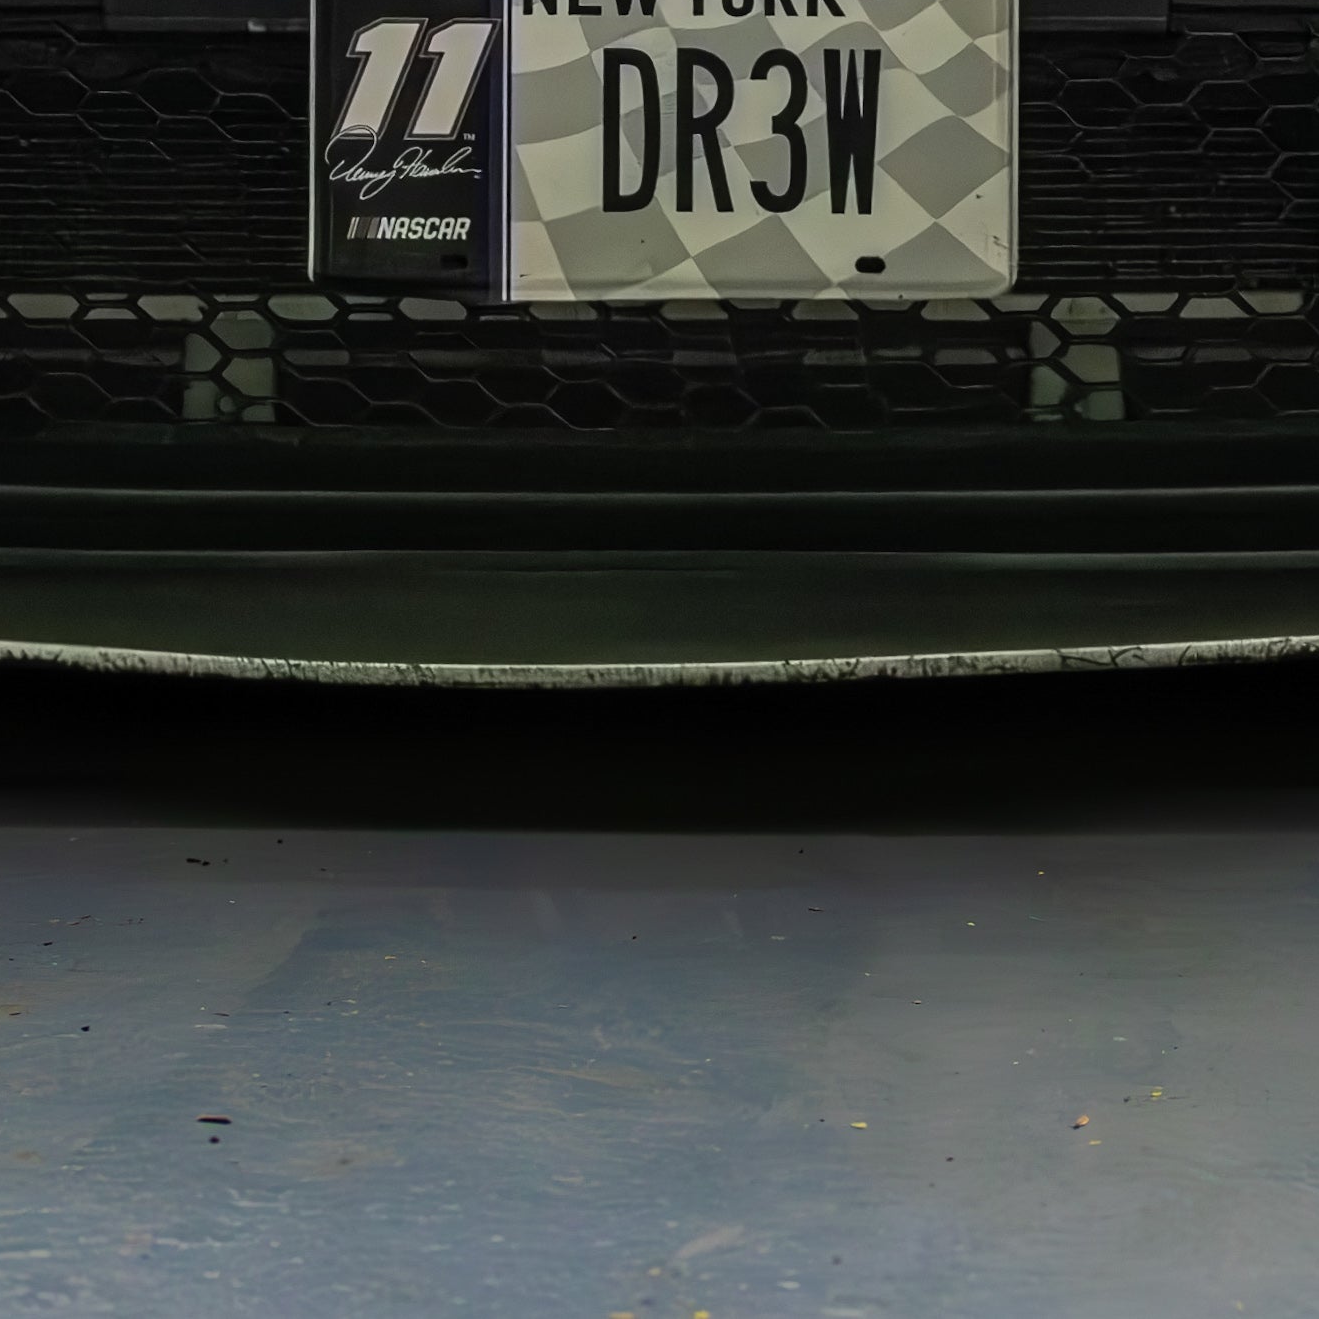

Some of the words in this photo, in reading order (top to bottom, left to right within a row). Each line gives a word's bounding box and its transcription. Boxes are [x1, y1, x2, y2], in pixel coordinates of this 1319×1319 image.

[332, 17, 502, 141] 11
[602, 46, 882, 216] DR3W
[376, 216, 472, 241] NASCAR
